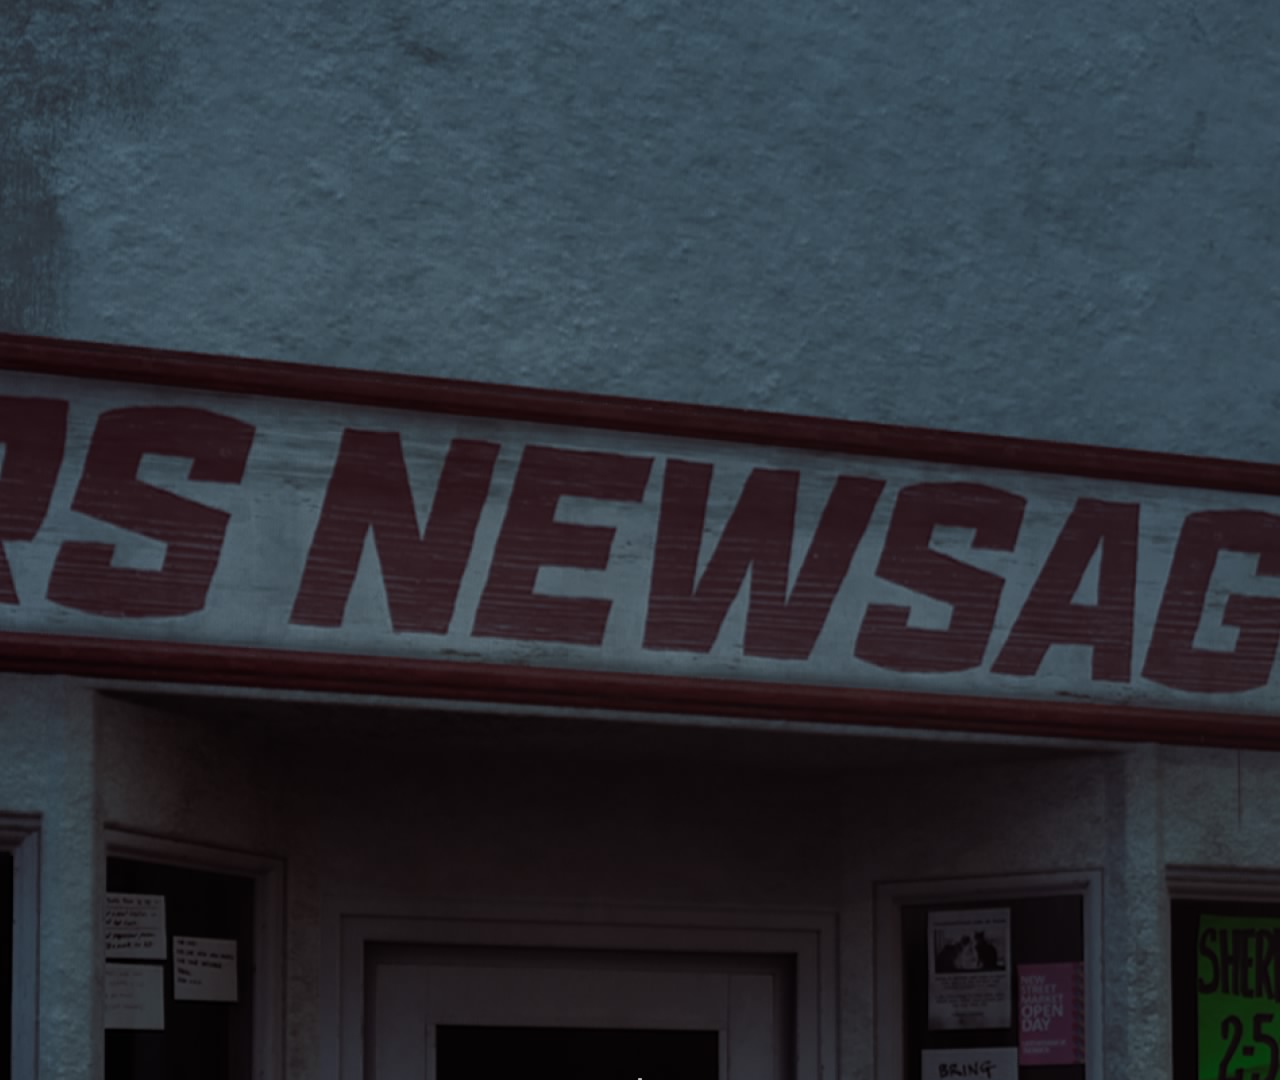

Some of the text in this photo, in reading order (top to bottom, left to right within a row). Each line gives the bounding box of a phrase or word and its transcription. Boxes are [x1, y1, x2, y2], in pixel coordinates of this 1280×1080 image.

[1021, 1004, 1064, 1018] OPEN
[1022, 1018, 1051, 1033] DAY
[939, 1060, 997, 1079] BRING
